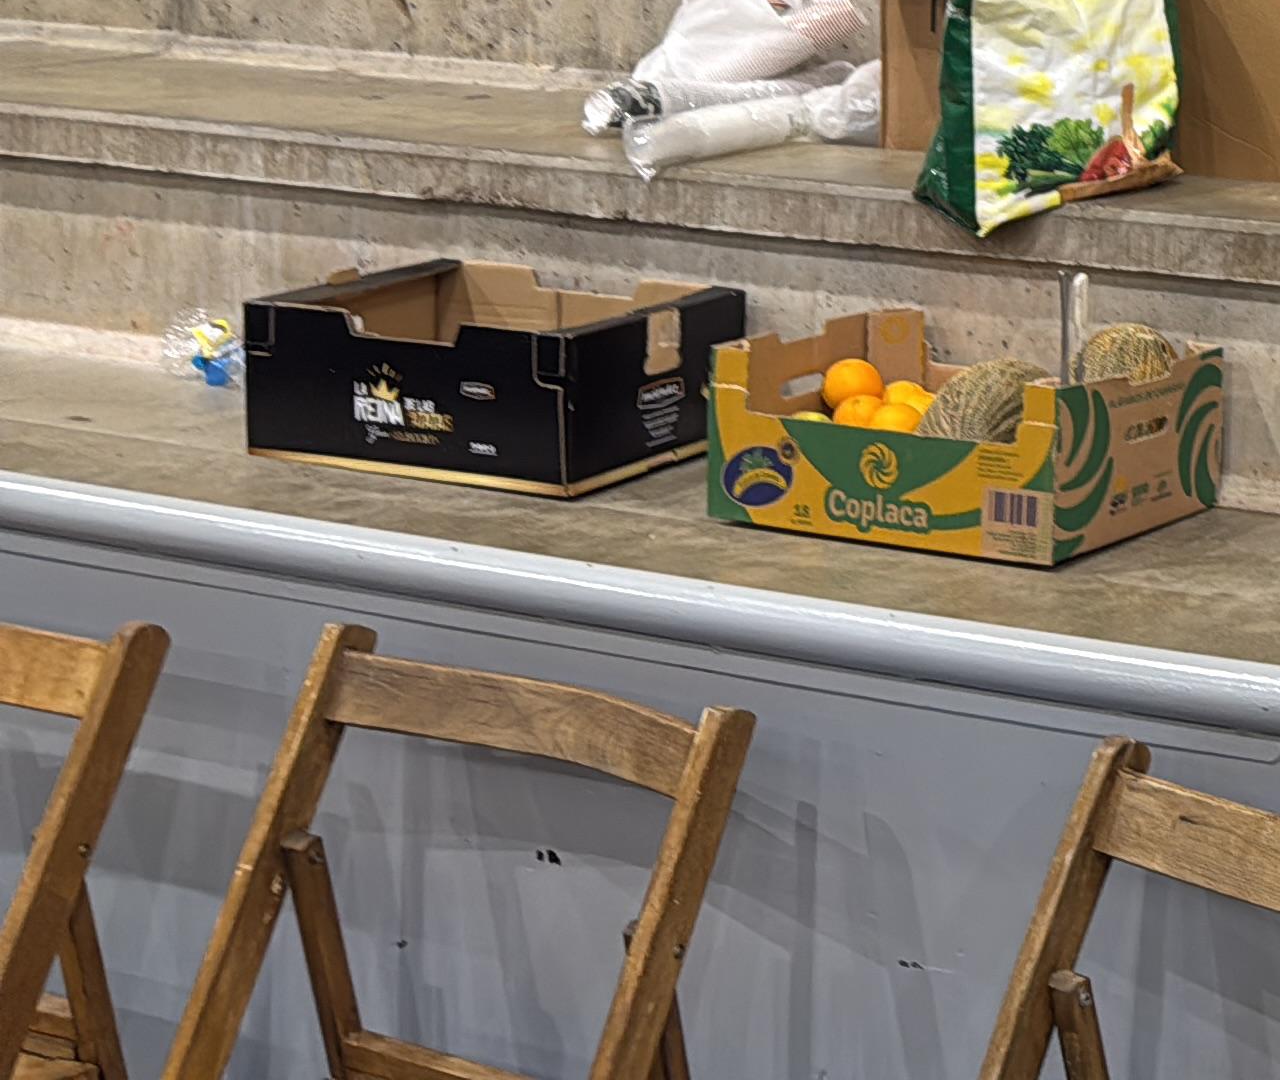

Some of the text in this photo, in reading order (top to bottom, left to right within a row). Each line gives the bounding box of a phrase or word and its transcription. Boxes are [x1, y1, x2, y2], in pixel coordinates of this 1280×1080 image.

[353, 381, 368, 396] LA
[353, 395, 405, 427] REINA
[828, 488, 929, 528] Coplaca
